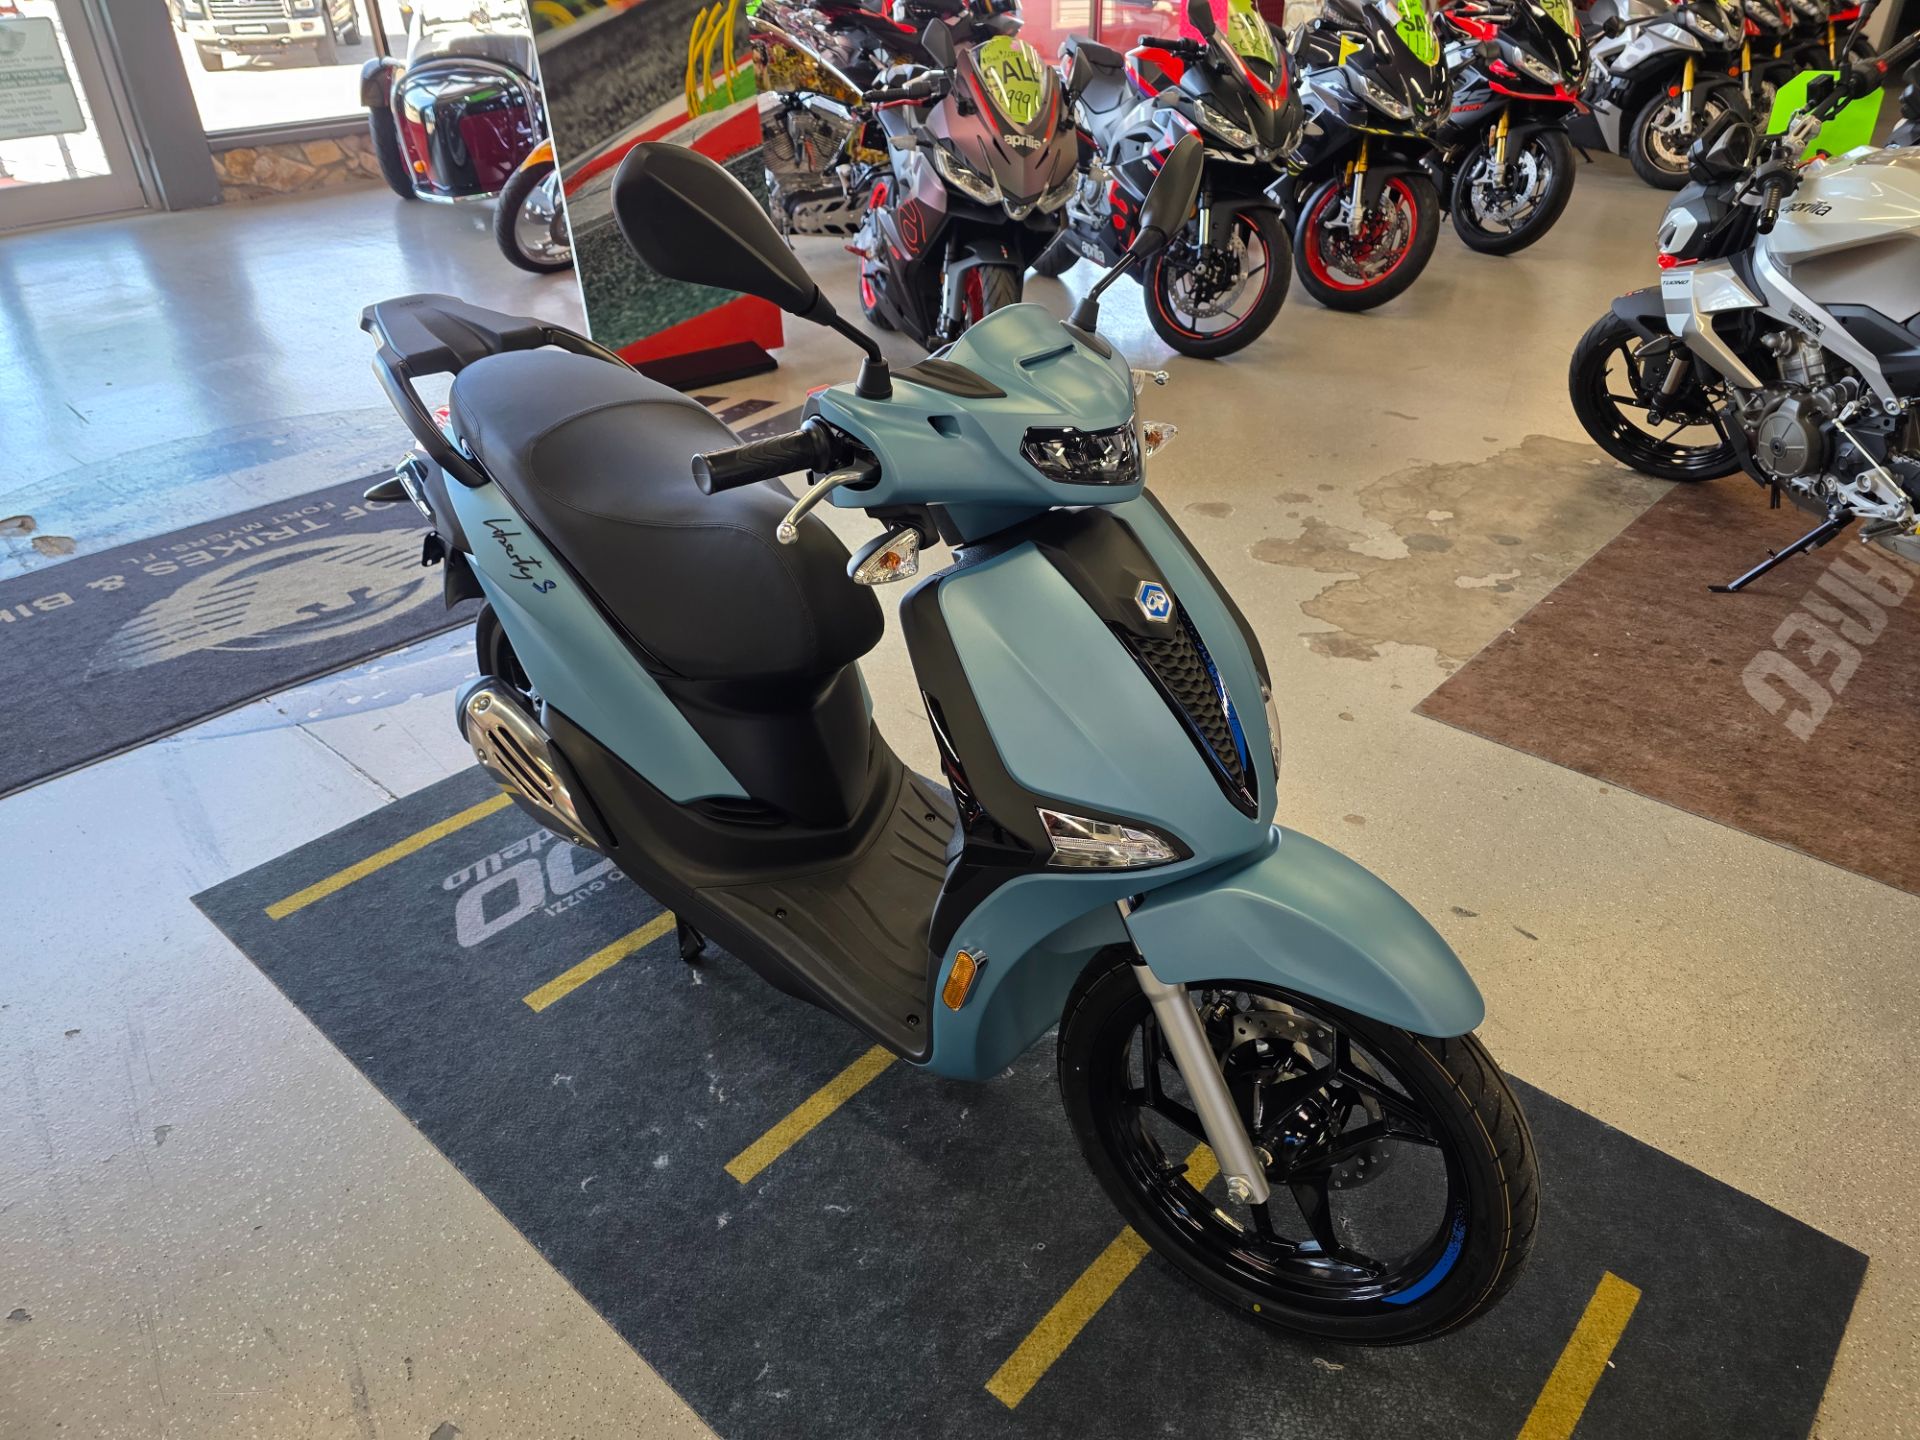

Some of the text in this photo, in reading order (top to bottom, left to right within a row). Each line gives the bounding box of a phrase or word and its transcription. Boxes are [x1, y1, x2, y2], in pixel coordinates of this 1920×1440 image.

[1402, 15, 1425, 31] SA
[1004, 134, 1043, 150] aprilia
[271, 500, 337, 525] FORT
[142, 518, 331, 577] TRIKES
[482, 518, 543, 580] Liberty
[86, 575, 126, 592] &
[543, 880, 607, 918] GUZZI
